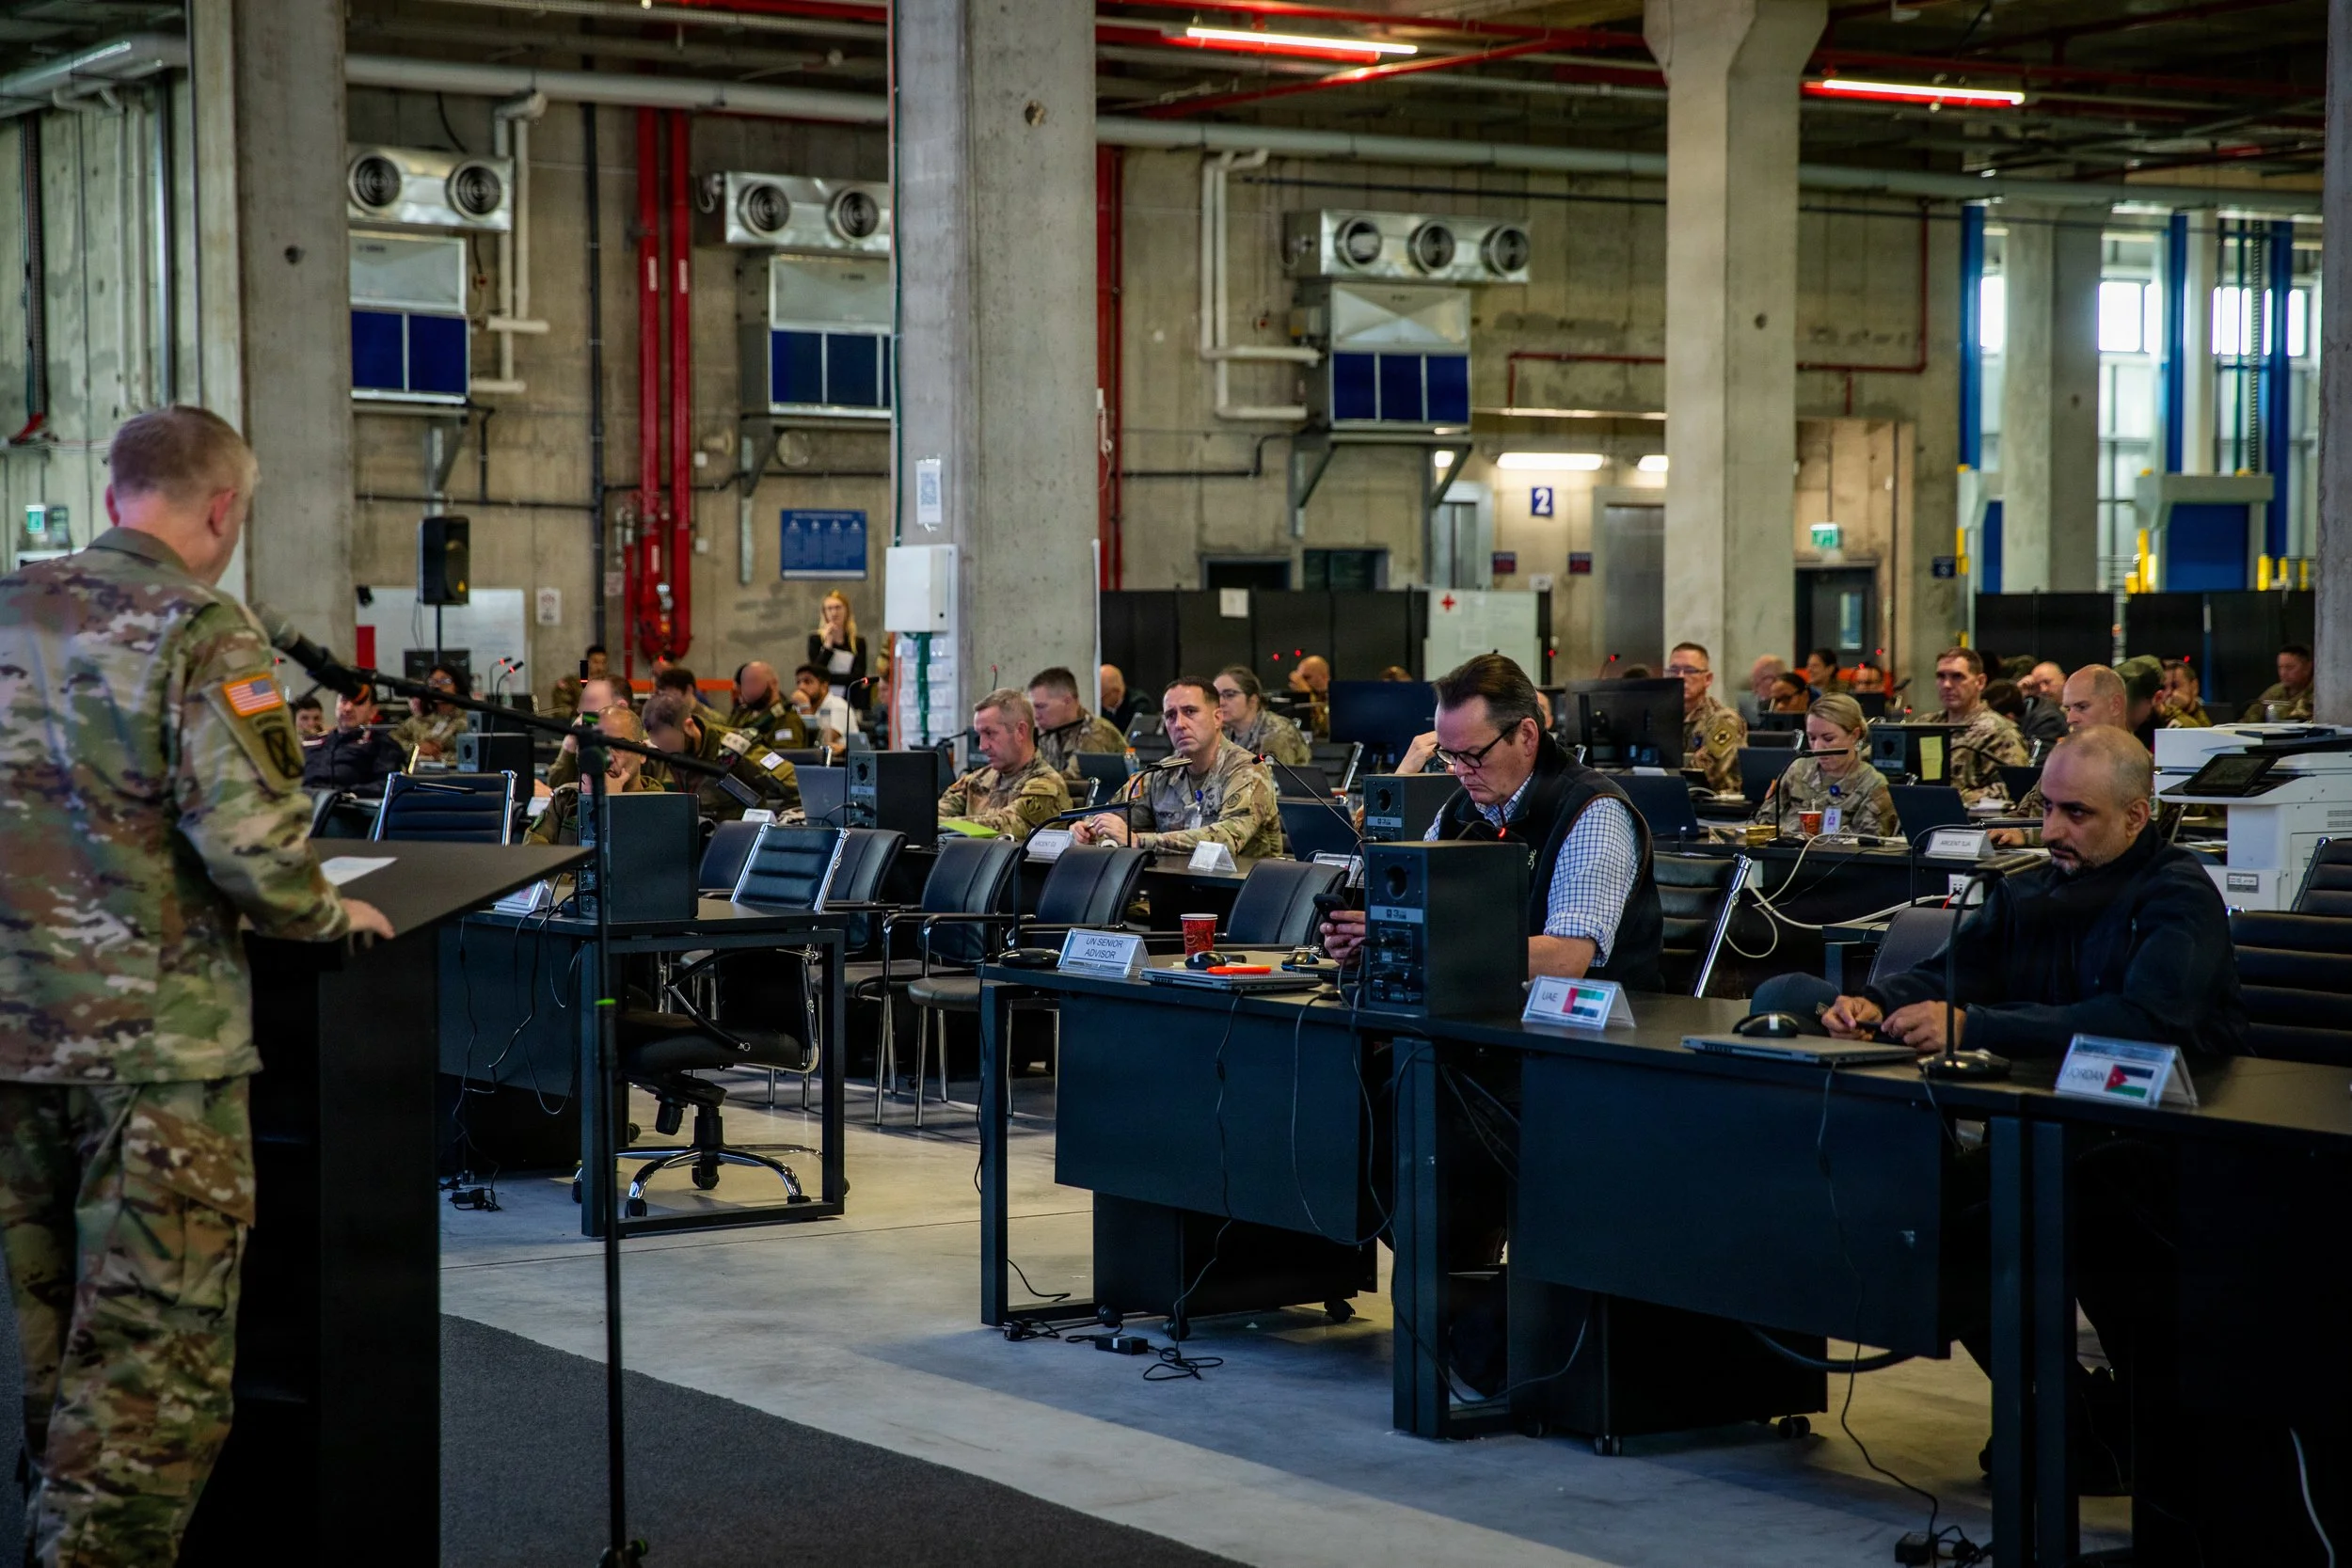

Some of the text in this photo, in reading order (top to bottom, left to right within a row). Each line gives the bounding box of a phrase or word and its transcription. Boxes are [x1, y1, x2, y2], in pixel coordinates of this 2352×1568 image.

[1534, 488, 1550, 514] 2
[1086, 937, 1123, 948] UN SENIOR
[1085, 948, 1117, 958] ADVISOR
[1541, 991, 1558, 1002] UAE
[2065, 1066, 2106, 1083] JORDAN
